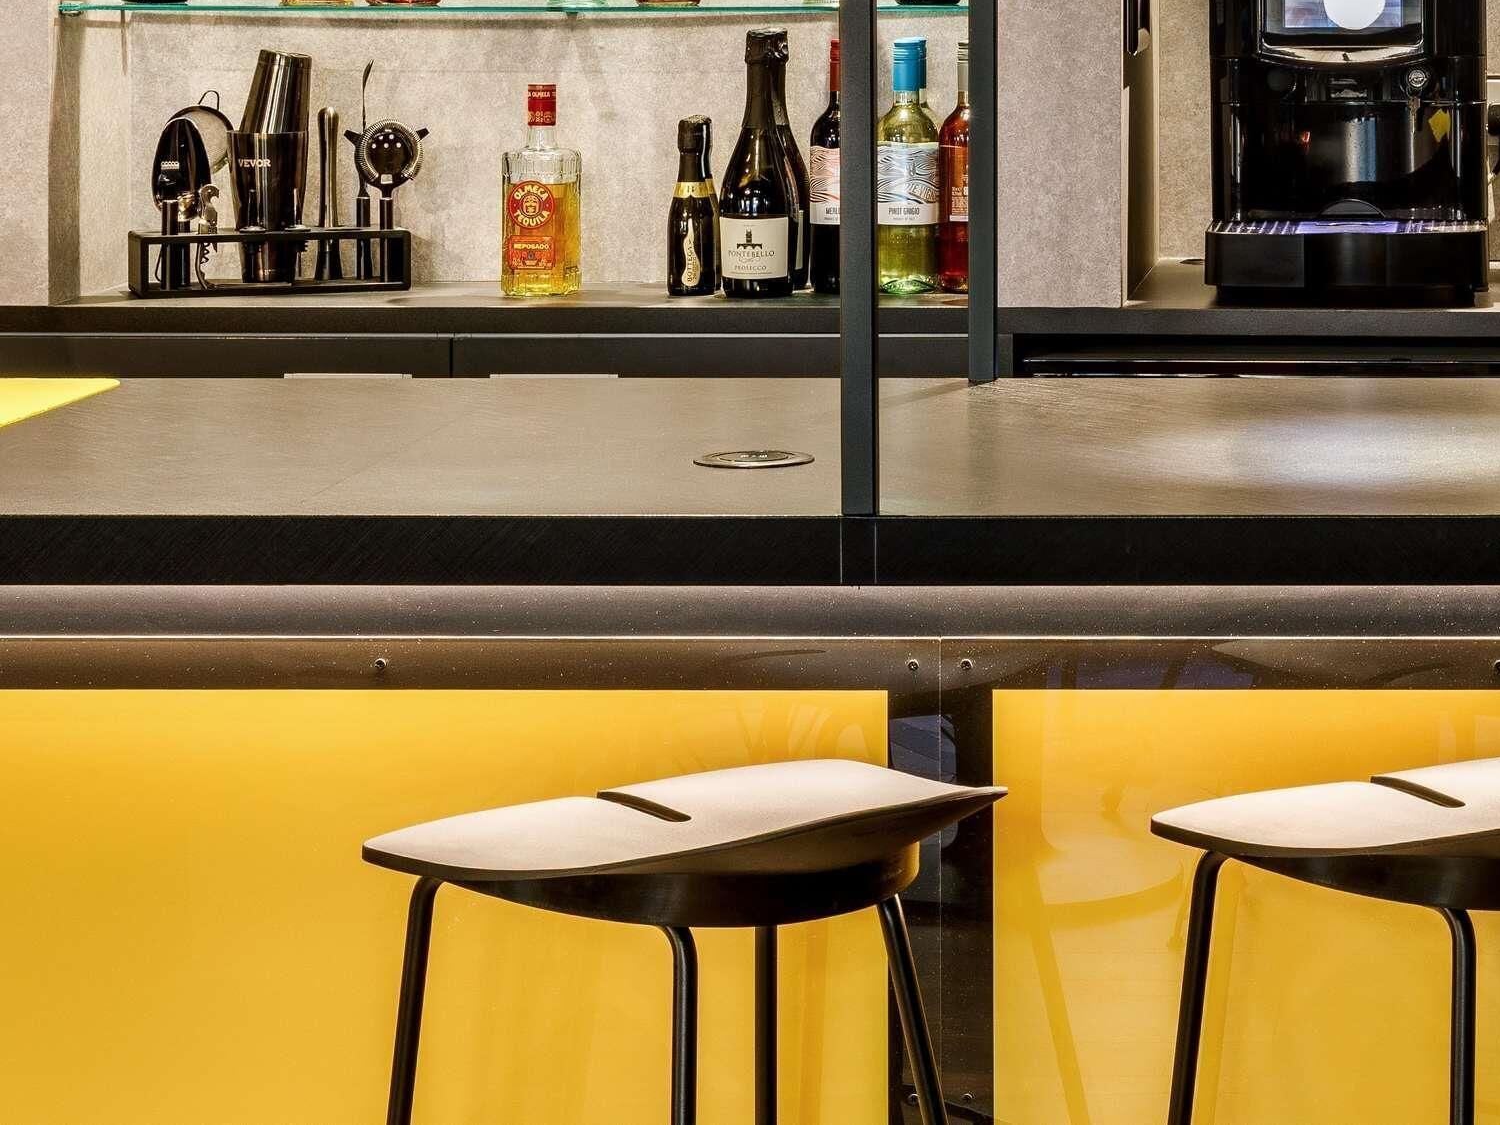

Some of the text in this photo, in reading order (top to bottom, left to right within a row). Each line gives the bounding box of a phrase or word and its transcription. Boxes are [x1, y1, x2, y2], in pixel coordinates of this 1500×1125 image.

[238, 159, 271, 168] VEVOR
[513, 183, 550, 201] OLMECA
[514, 209, 550, 226] TEQUILA
[888, 207, 920, 216] PINOT GRIGIO
